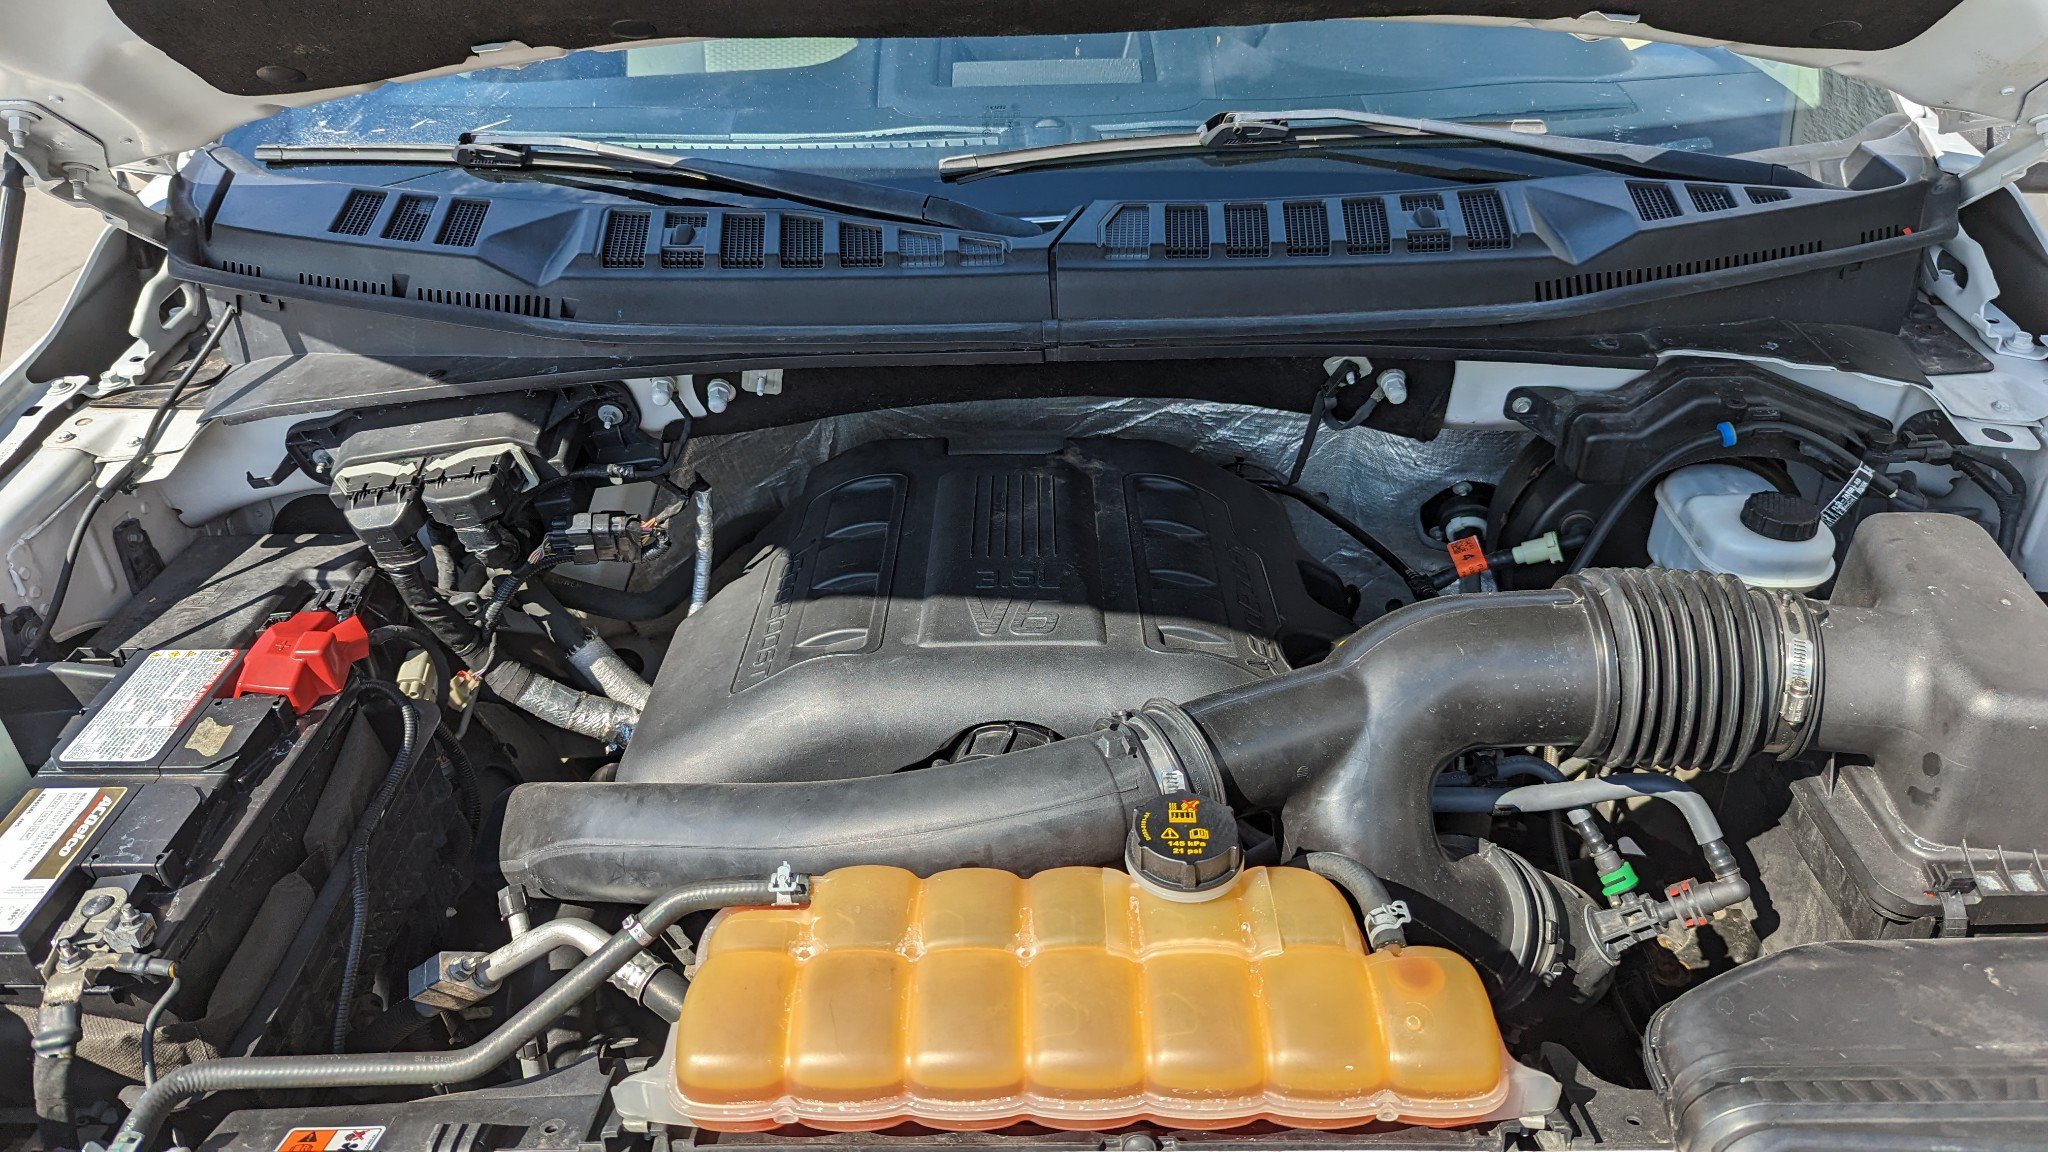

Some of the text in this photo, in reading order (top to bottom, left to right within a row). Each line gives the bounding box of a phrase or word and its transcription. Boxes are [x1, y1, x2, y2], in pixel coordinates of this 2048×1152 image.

[976, 569, 1060, 589] 3.5L
[965, 594, 1060, 636] V6
[59, 795, 112, 857] ACDelco
